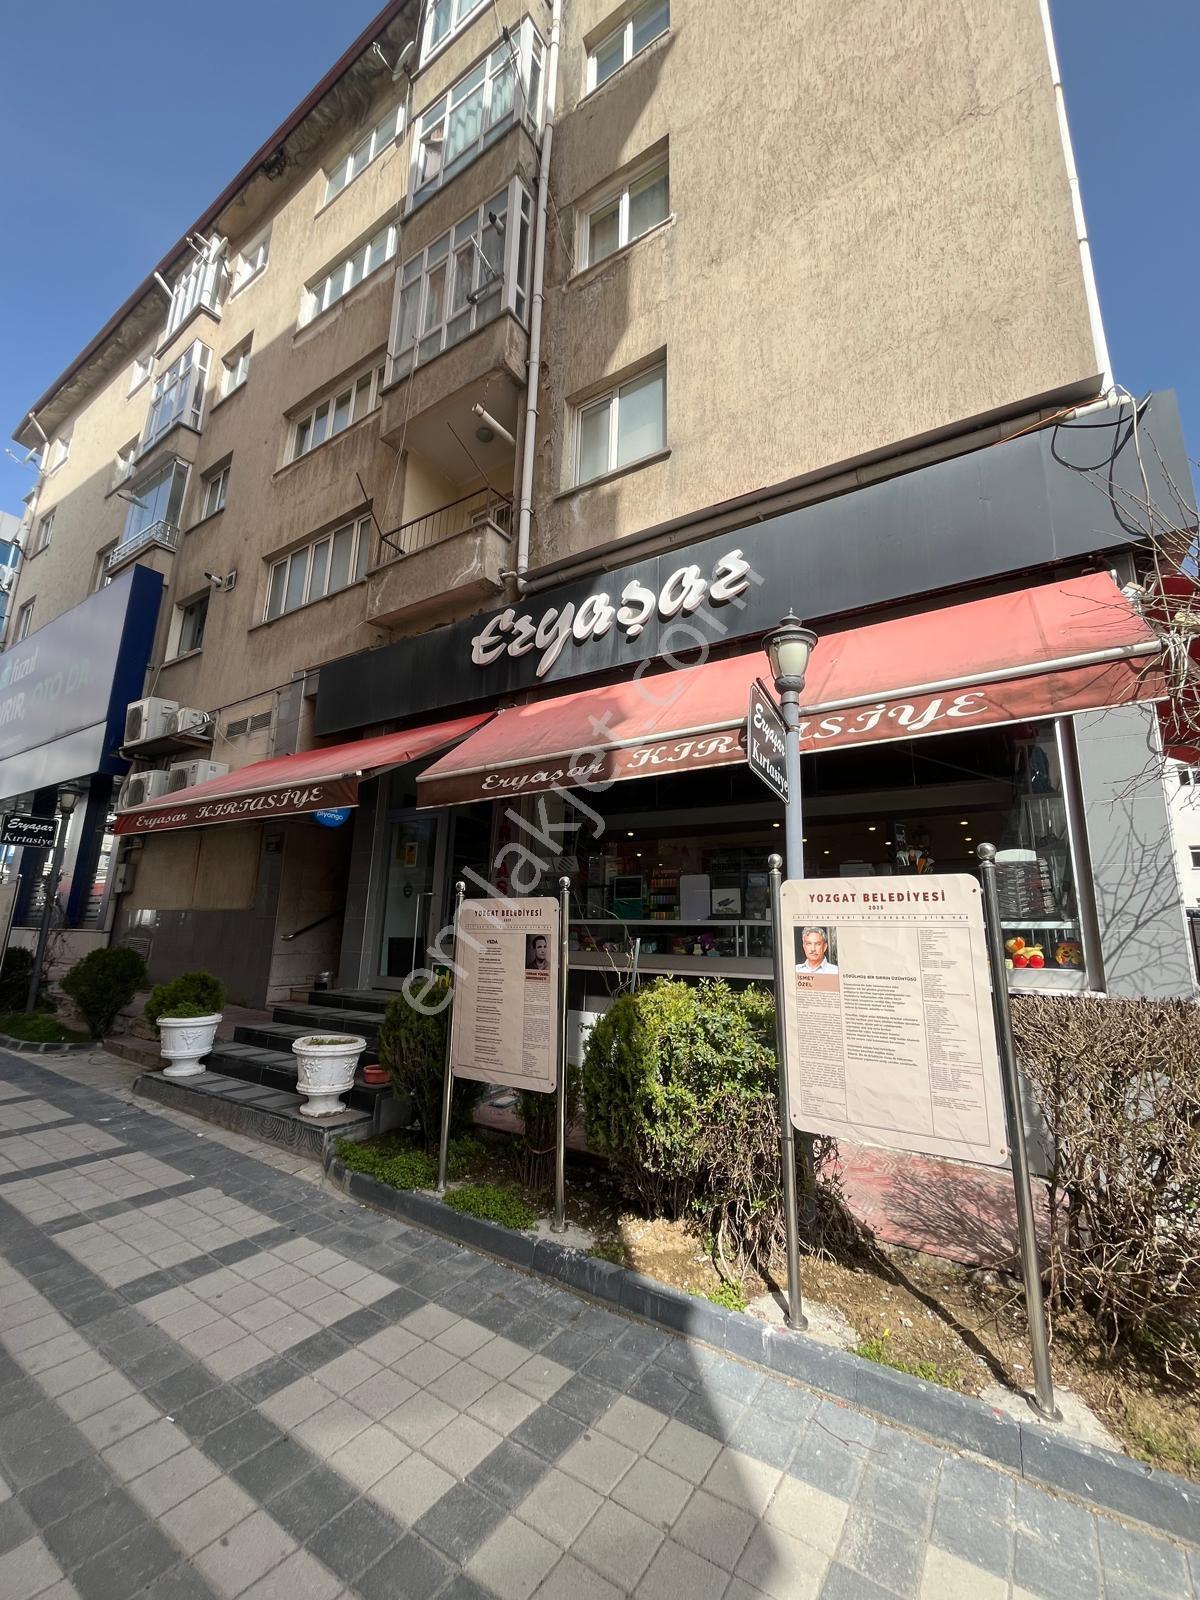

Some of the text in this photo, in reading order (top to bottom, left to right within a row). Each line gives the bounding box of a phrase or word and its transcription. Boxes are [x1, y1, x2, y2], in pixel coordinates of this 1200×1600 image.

[471, 549, 751, 677] Eryaşar
[627, 692, 988, 769] KIRSİYE
[752, 738, 788, 792] Kırtasiye
[195, 786, 324, 819] KIRTASİYE
[3, 832, 54, 847] Kırtasiye
[501, 908, 542, 917] BELEDİYESİ
[809, 890, 946, 903] YOZGAT BELEDİYESİ
